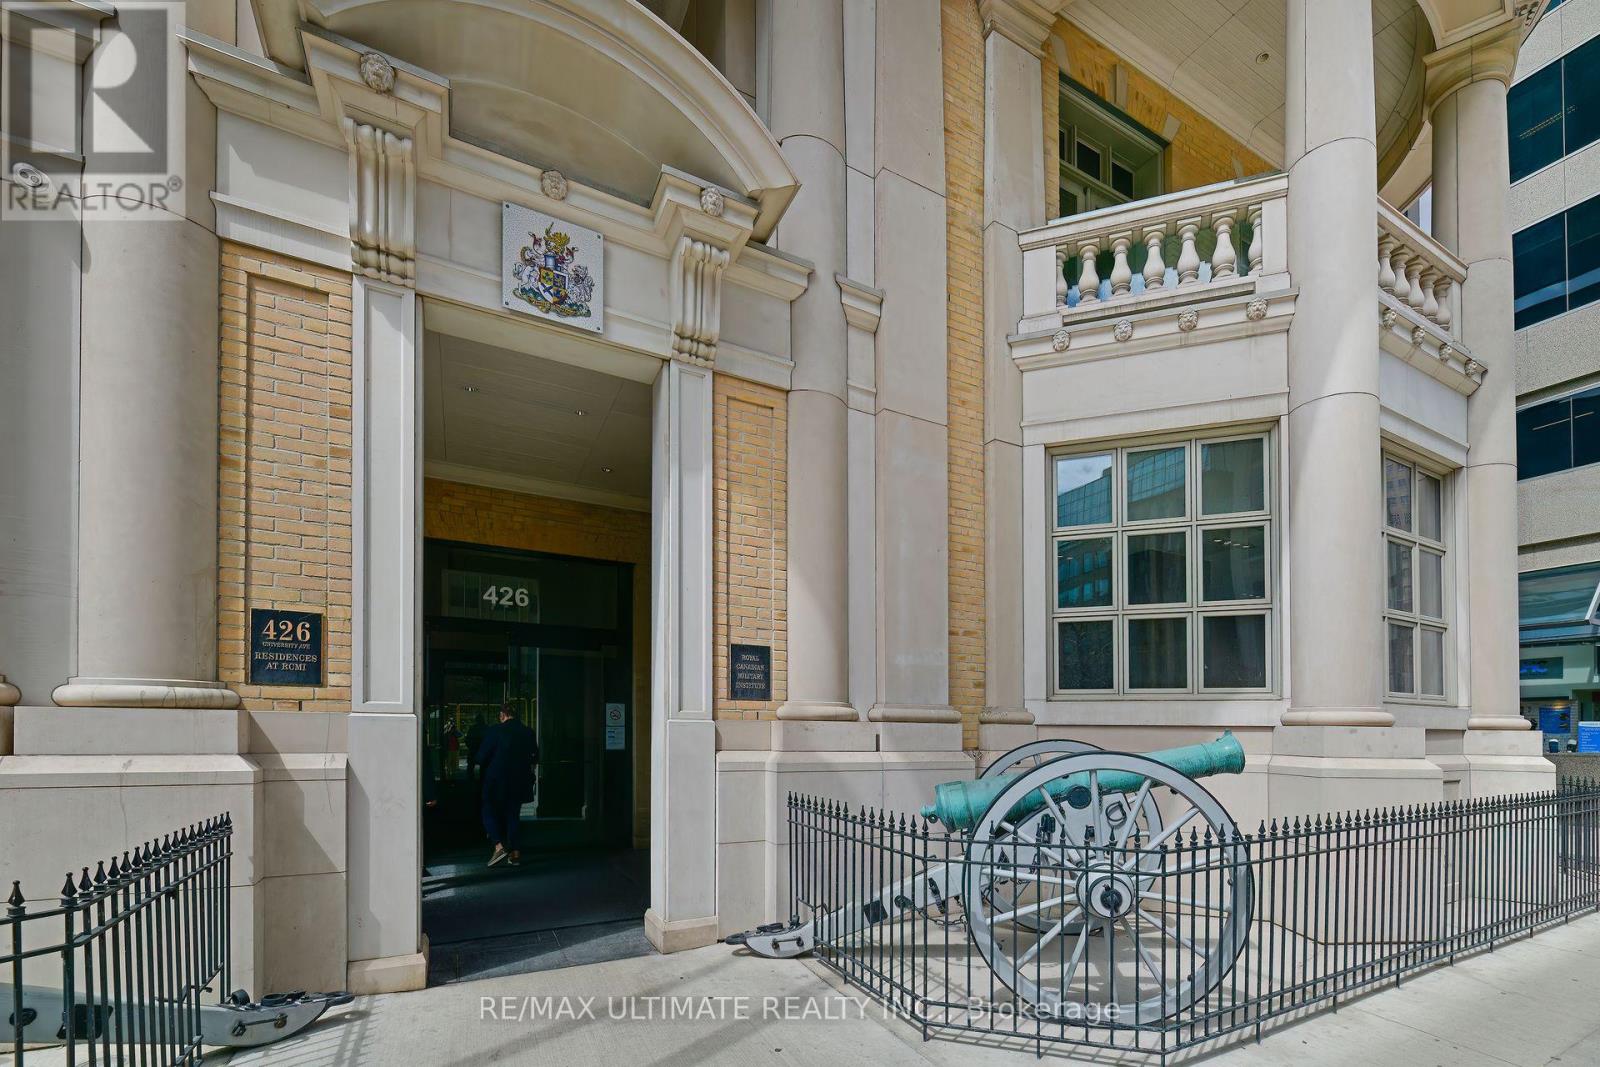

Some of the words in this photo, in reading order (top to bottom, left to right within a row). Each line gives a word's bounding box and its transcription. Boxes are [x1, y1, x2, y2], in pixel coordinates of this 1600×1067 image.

[482, 585, 529, 607] 426
[261, 619, 311, 642] 426
[255, 651, 318, 663] RESIDENCES
[741, 654, 760, 662] ROYAL
[265, 662, 279, 670] AT
[280, 662, 307, 671] RCMI
